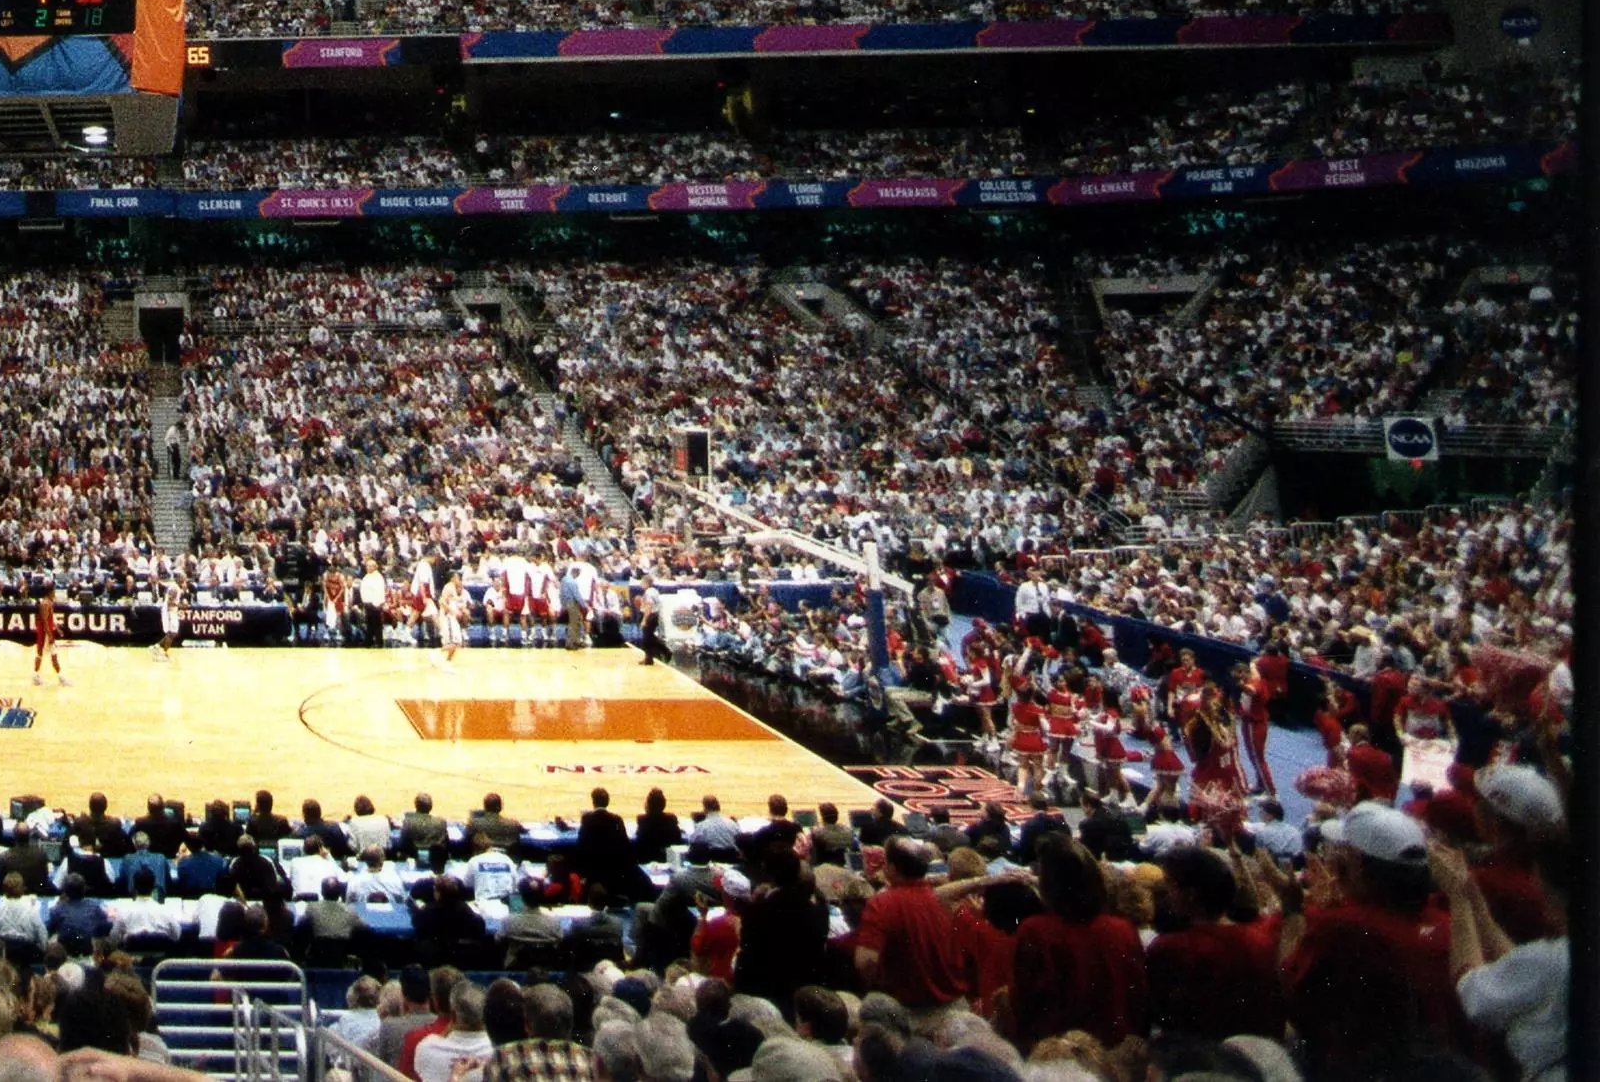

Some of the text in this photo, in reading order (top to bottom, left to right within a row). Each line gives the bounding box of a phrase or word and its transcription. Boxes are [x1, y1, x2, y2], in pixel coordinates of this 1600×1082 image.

[35, 10, 48, 27] 2
[186, 46, 210, 64] 65
[319, 46, 363, 58] STANFORD
[1327, 159, 1360, 171] WEST
[1229, 166, 1255, 179] VIEW
[1324, 172, 1365, 185] REGION
[686, 184, 727, 195] WESTERN
[979, 180, 1019, 191] COLLEGE
[1081, 181, 1136, 195] DELAWARE
[494, 187, 528, 198] MURRAY
[587, 191, 627, 204] DETROIT
[878, 186, 938, 199] VALPARAISO
[979, 191, 1036, 203] CHARLESTON
[89, 196, 138, 208] FINAL FOUR
[197, 199, 242, 210] CLEMSON
[379, 196, 449, 208] RHODE ISLAND
[500, 199, 525, 210] STATE
[688, 195, 729, 207] MICHIGAN
[796, 194, 820, 206] STATE
[177, 610, 243, 622] STANFORD
[53, 613, 127, 632] FOUR
[192, 623, 226, 635] UTAH
